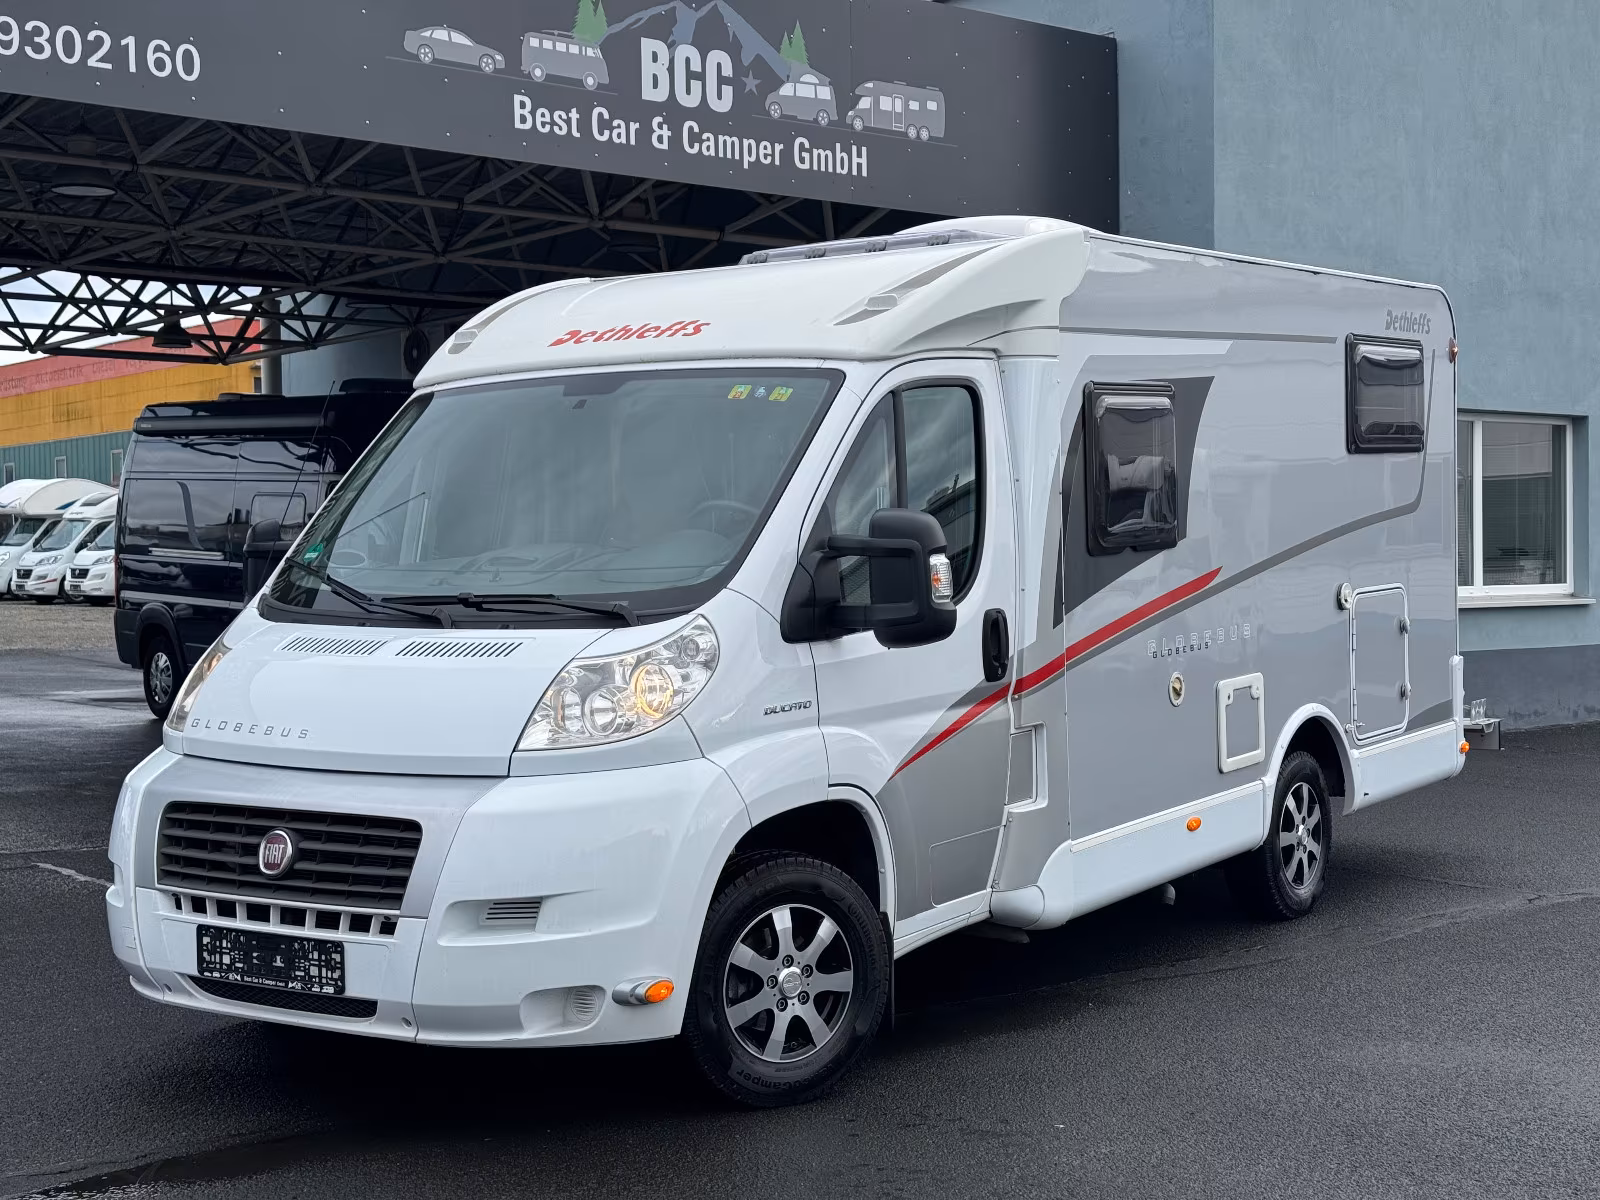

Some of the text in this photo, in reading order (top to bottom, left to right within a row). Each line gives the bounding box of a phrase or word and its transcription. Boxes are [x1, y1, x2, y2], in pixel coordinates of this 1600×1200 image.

[0, 15, 201, 81] 9302160
[641, 36, 734, 113] BCC
[513, 93, 868, 177] Best Car & Camper GmbH
[546, 319, 712, 348] Dethleffs
[1384, 309, 1432, 335] Dethleffs
[1152, 641, 1210, 659] GLOBEBUS
[763, 700, 813, 716] DUCATO
[191, 718, 309, 739] GLOBEBUS
[264, 843, 286, 864] FIAT
